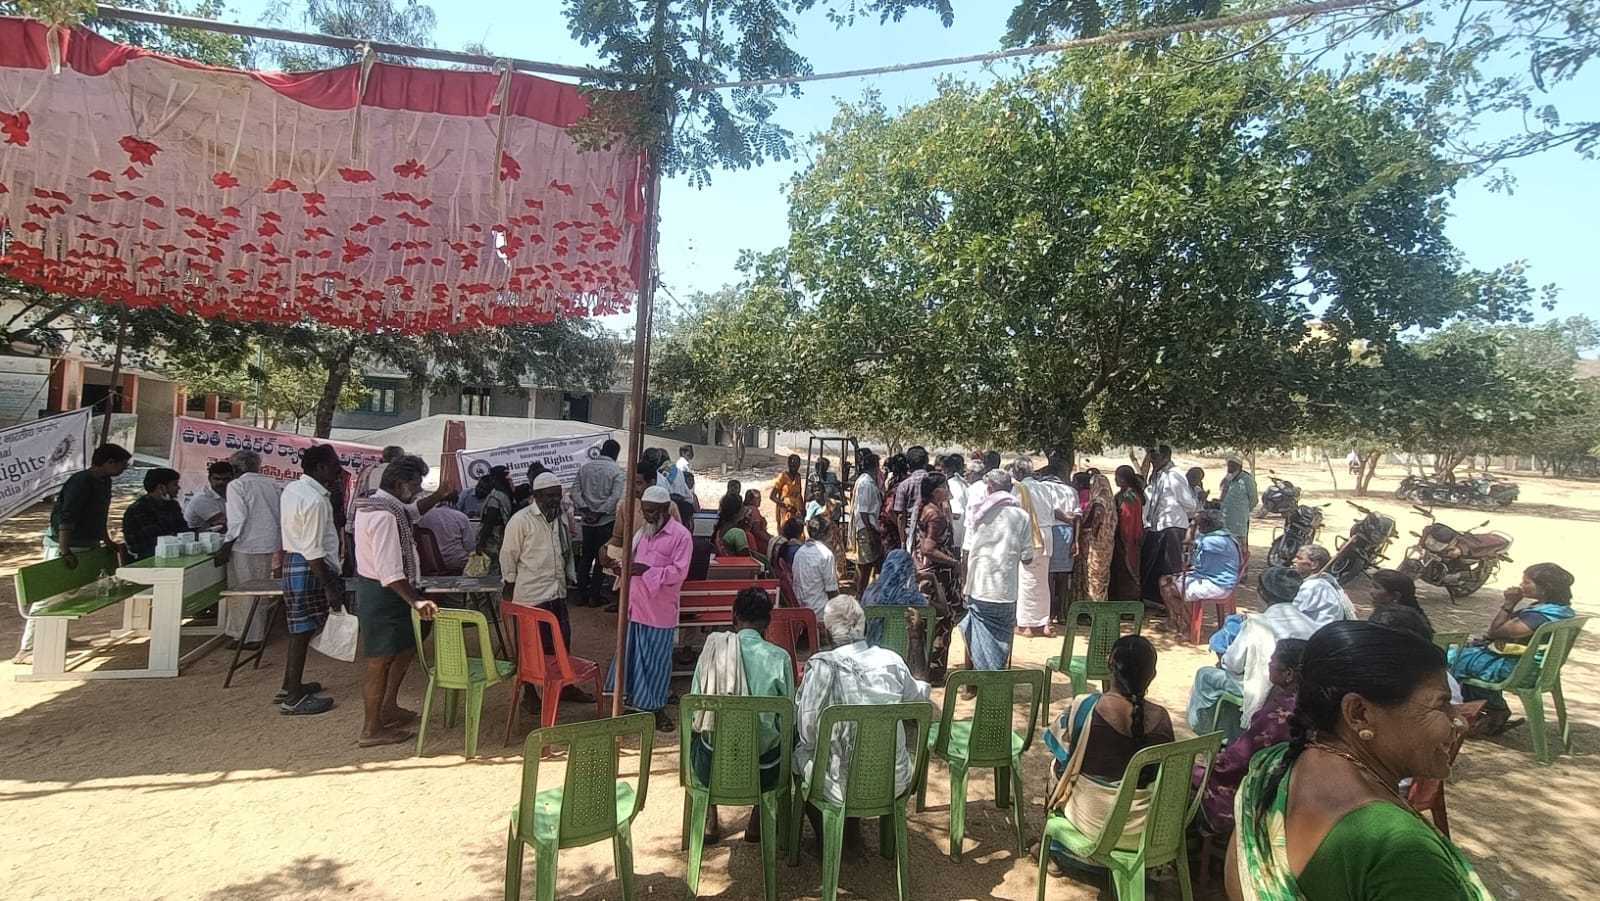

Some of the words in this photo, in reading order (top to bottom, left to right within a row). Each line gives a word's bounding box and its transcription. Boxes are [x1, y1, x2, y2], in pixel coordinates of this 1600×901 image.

[182, 426, 220, 446] ఉచిత
[0, 456, 46, 482] ights
[543, 454, 574, 466] Rights
